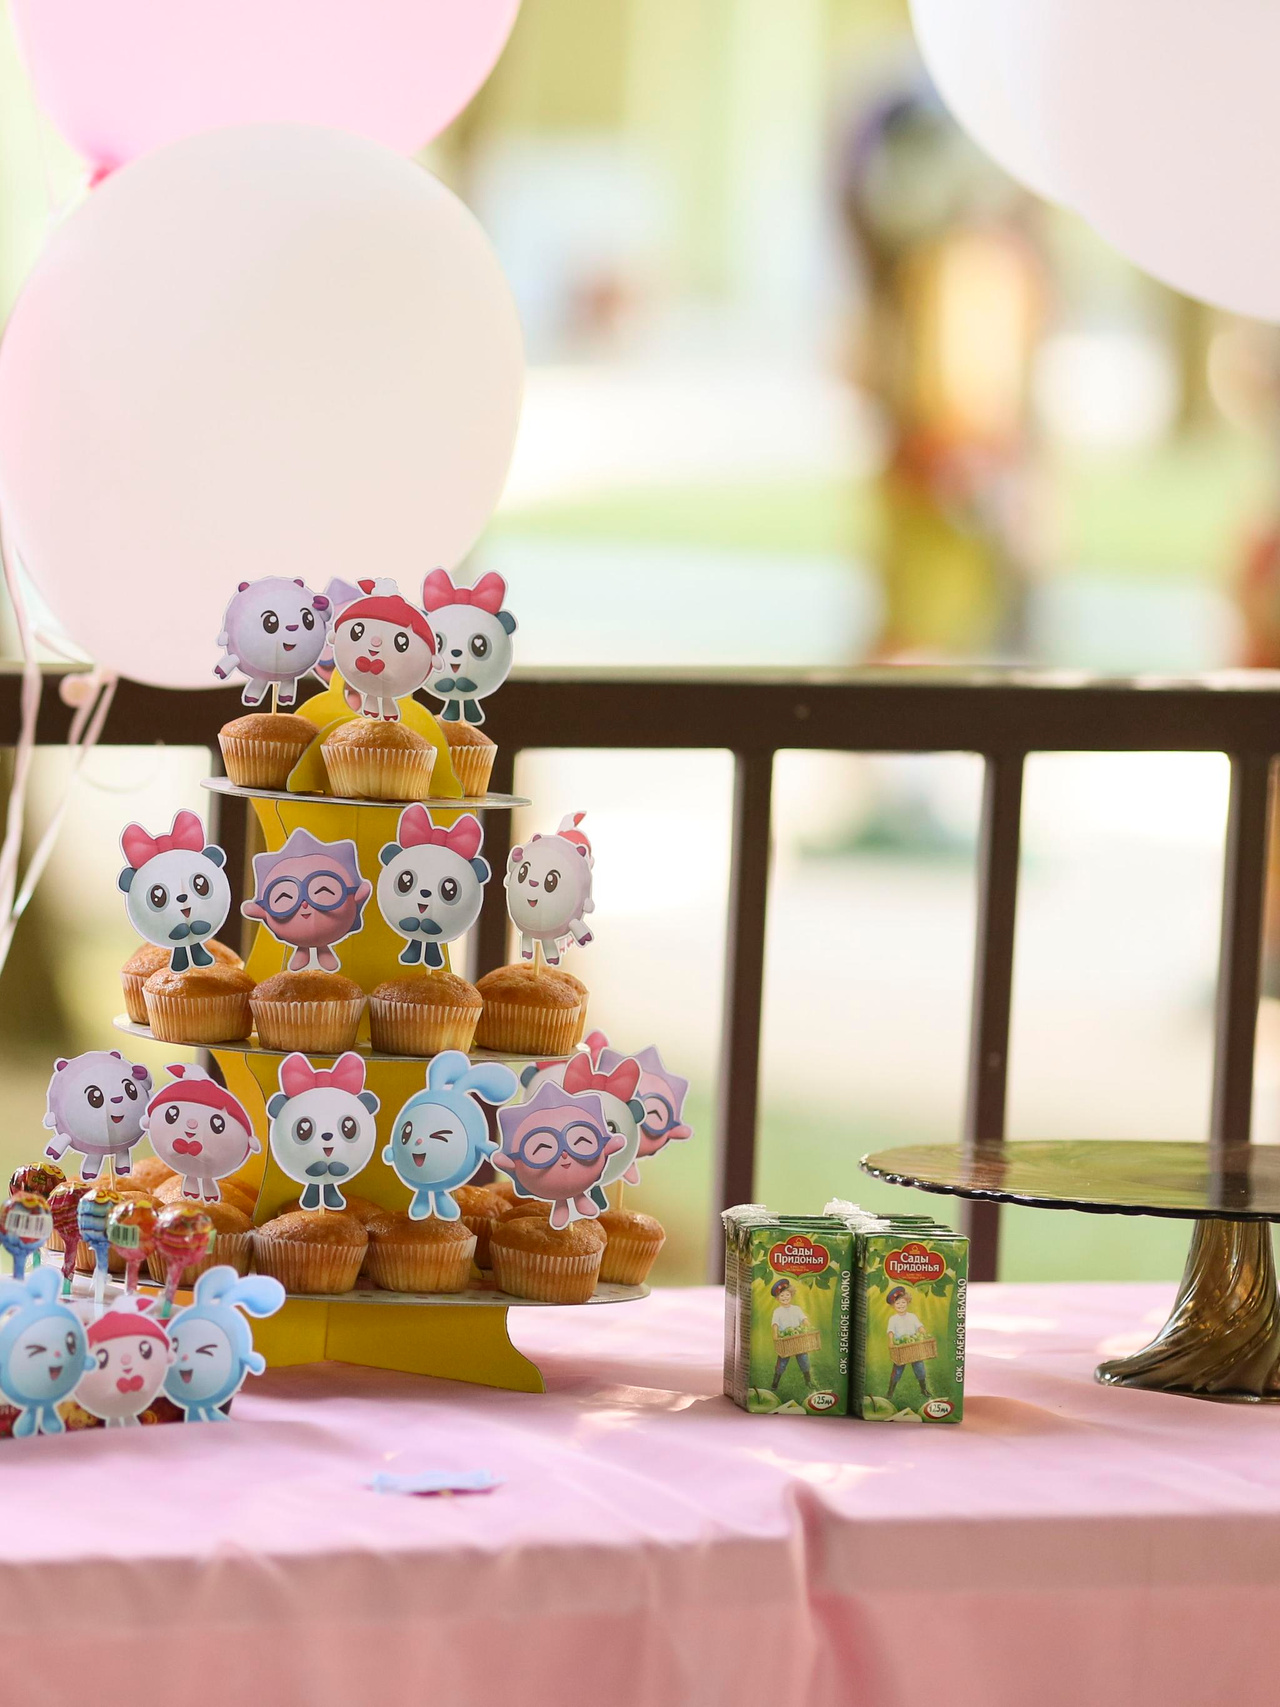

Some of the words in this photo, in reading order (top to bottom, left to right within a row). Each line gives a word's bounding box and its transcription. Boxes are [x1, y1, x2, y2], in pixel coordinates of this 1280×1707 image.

[784, 1244, 814, 1257] Сады
[900, 1252, 930, 1265] Сады
[774, 1252, 825, 1266] Придонья
[889, 1260, 941, 1274] Придонья
[840, 1270, 851, 1312] ЯБЛОКО
[956, 1278, 967, 1319] ЯБЛОКО
[839, 1357, 848, 1375] СОК
[955, 1365, 964, 1383] СОК
